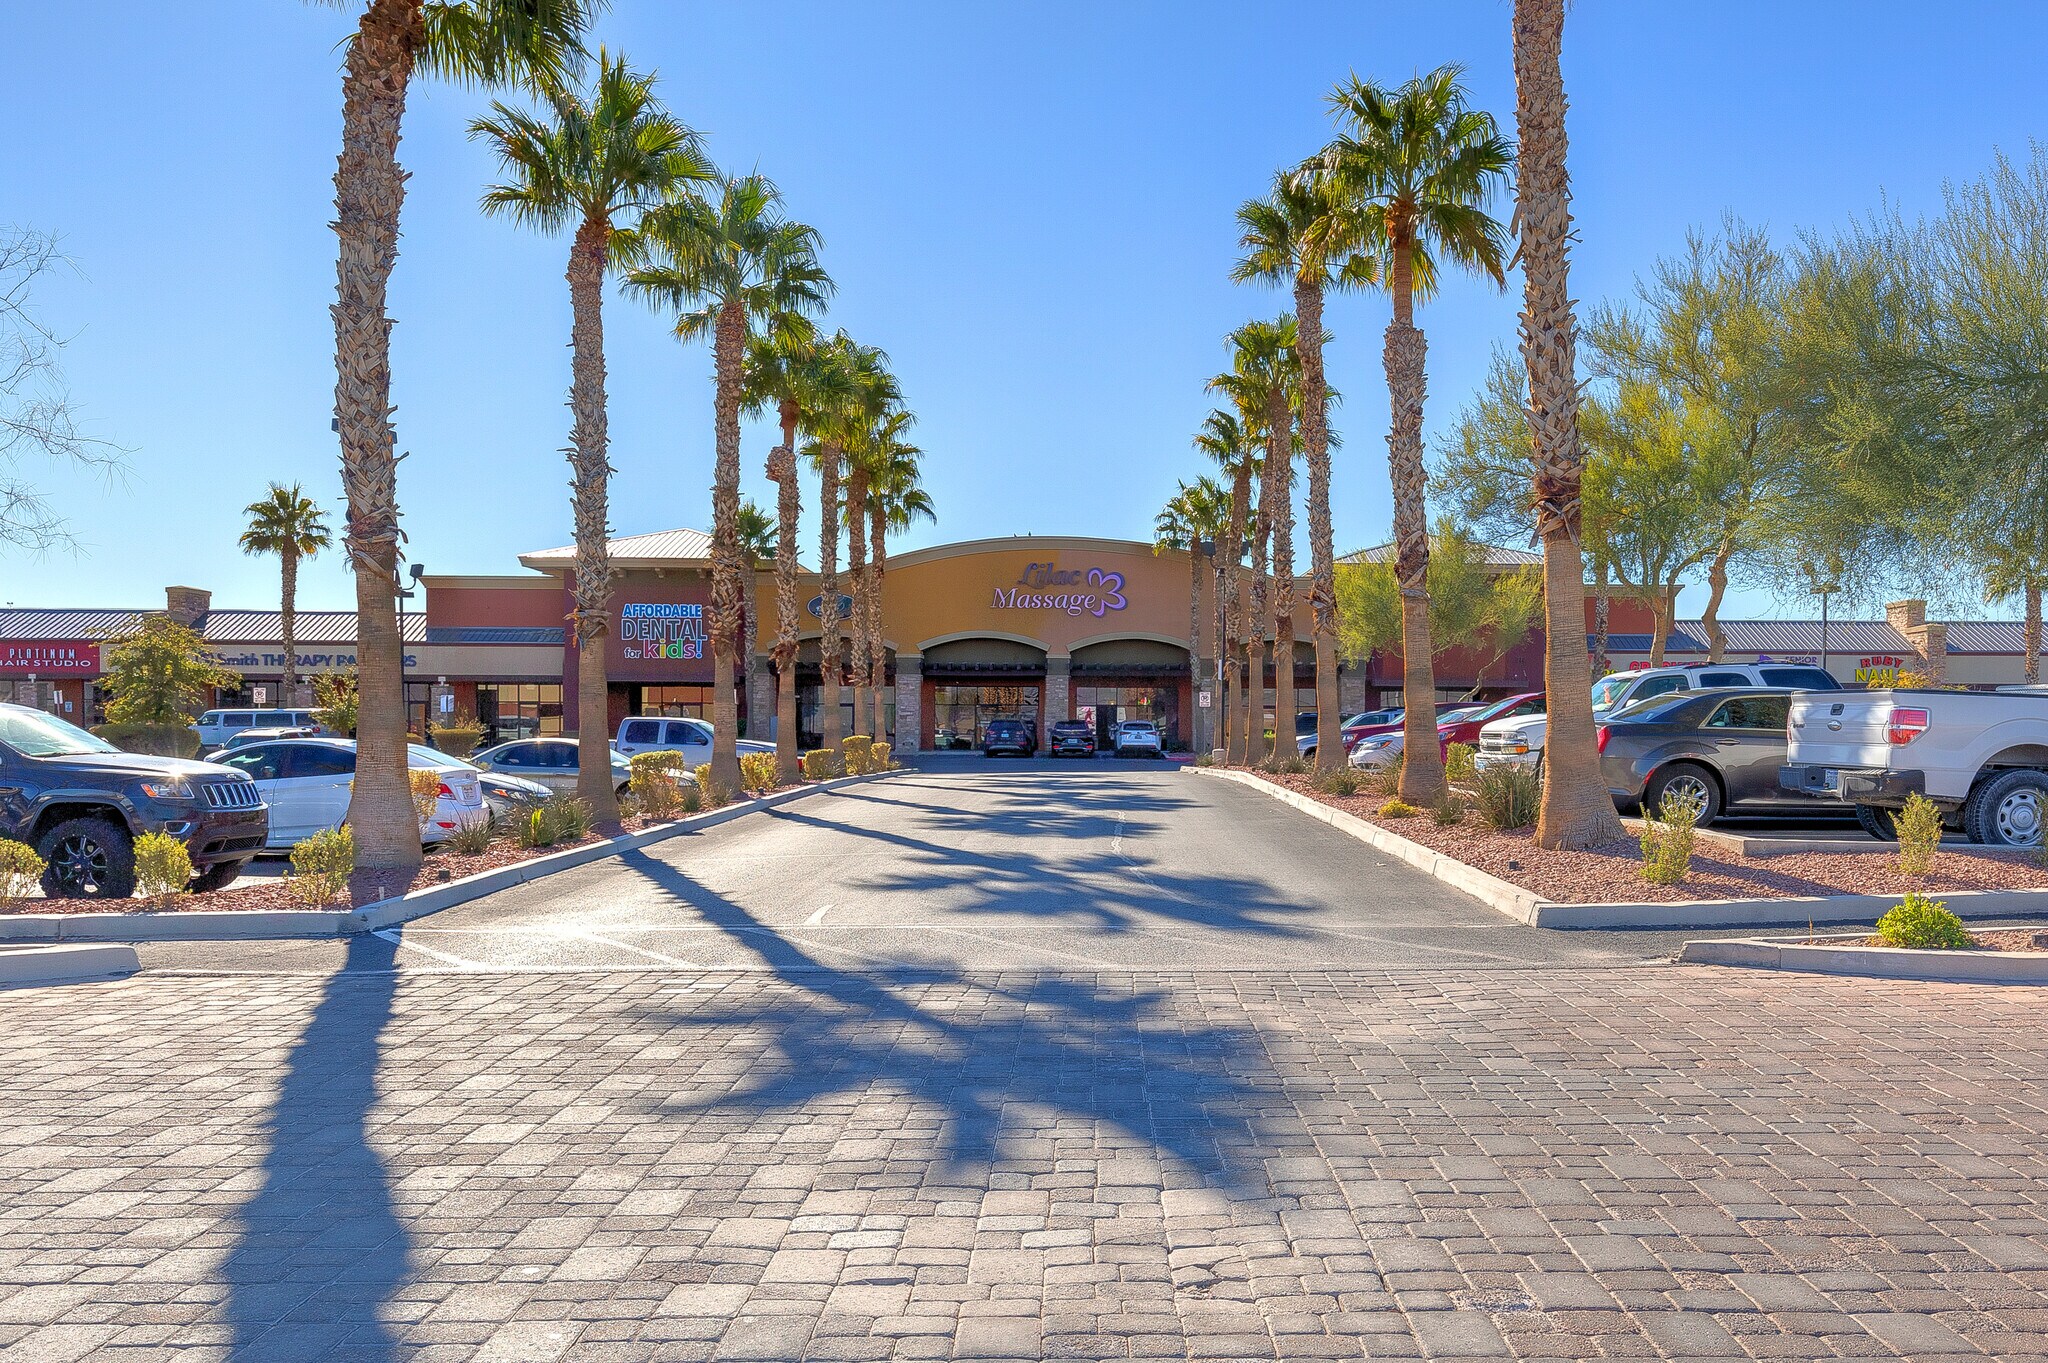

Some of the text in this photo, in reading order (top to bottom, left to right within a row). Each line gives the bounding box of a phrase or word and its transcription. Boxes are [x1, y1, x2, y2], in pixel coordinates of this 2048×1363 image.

[1017, 562, 1081, 589] Lilac
[990, 587, 1096, 616] Massage
[622, 603, 703, 618] AFFORDABLE
[621, 618, 708, 641] DENTAL
[9, 648, 76, 660] PLATINUM
[624, 638, 703, 659] for kids!
[33, 659, 92, 667] STUDIO
[217, 652, 259, 666] Smith
[1860, 655, 1904, 668] RUBY
